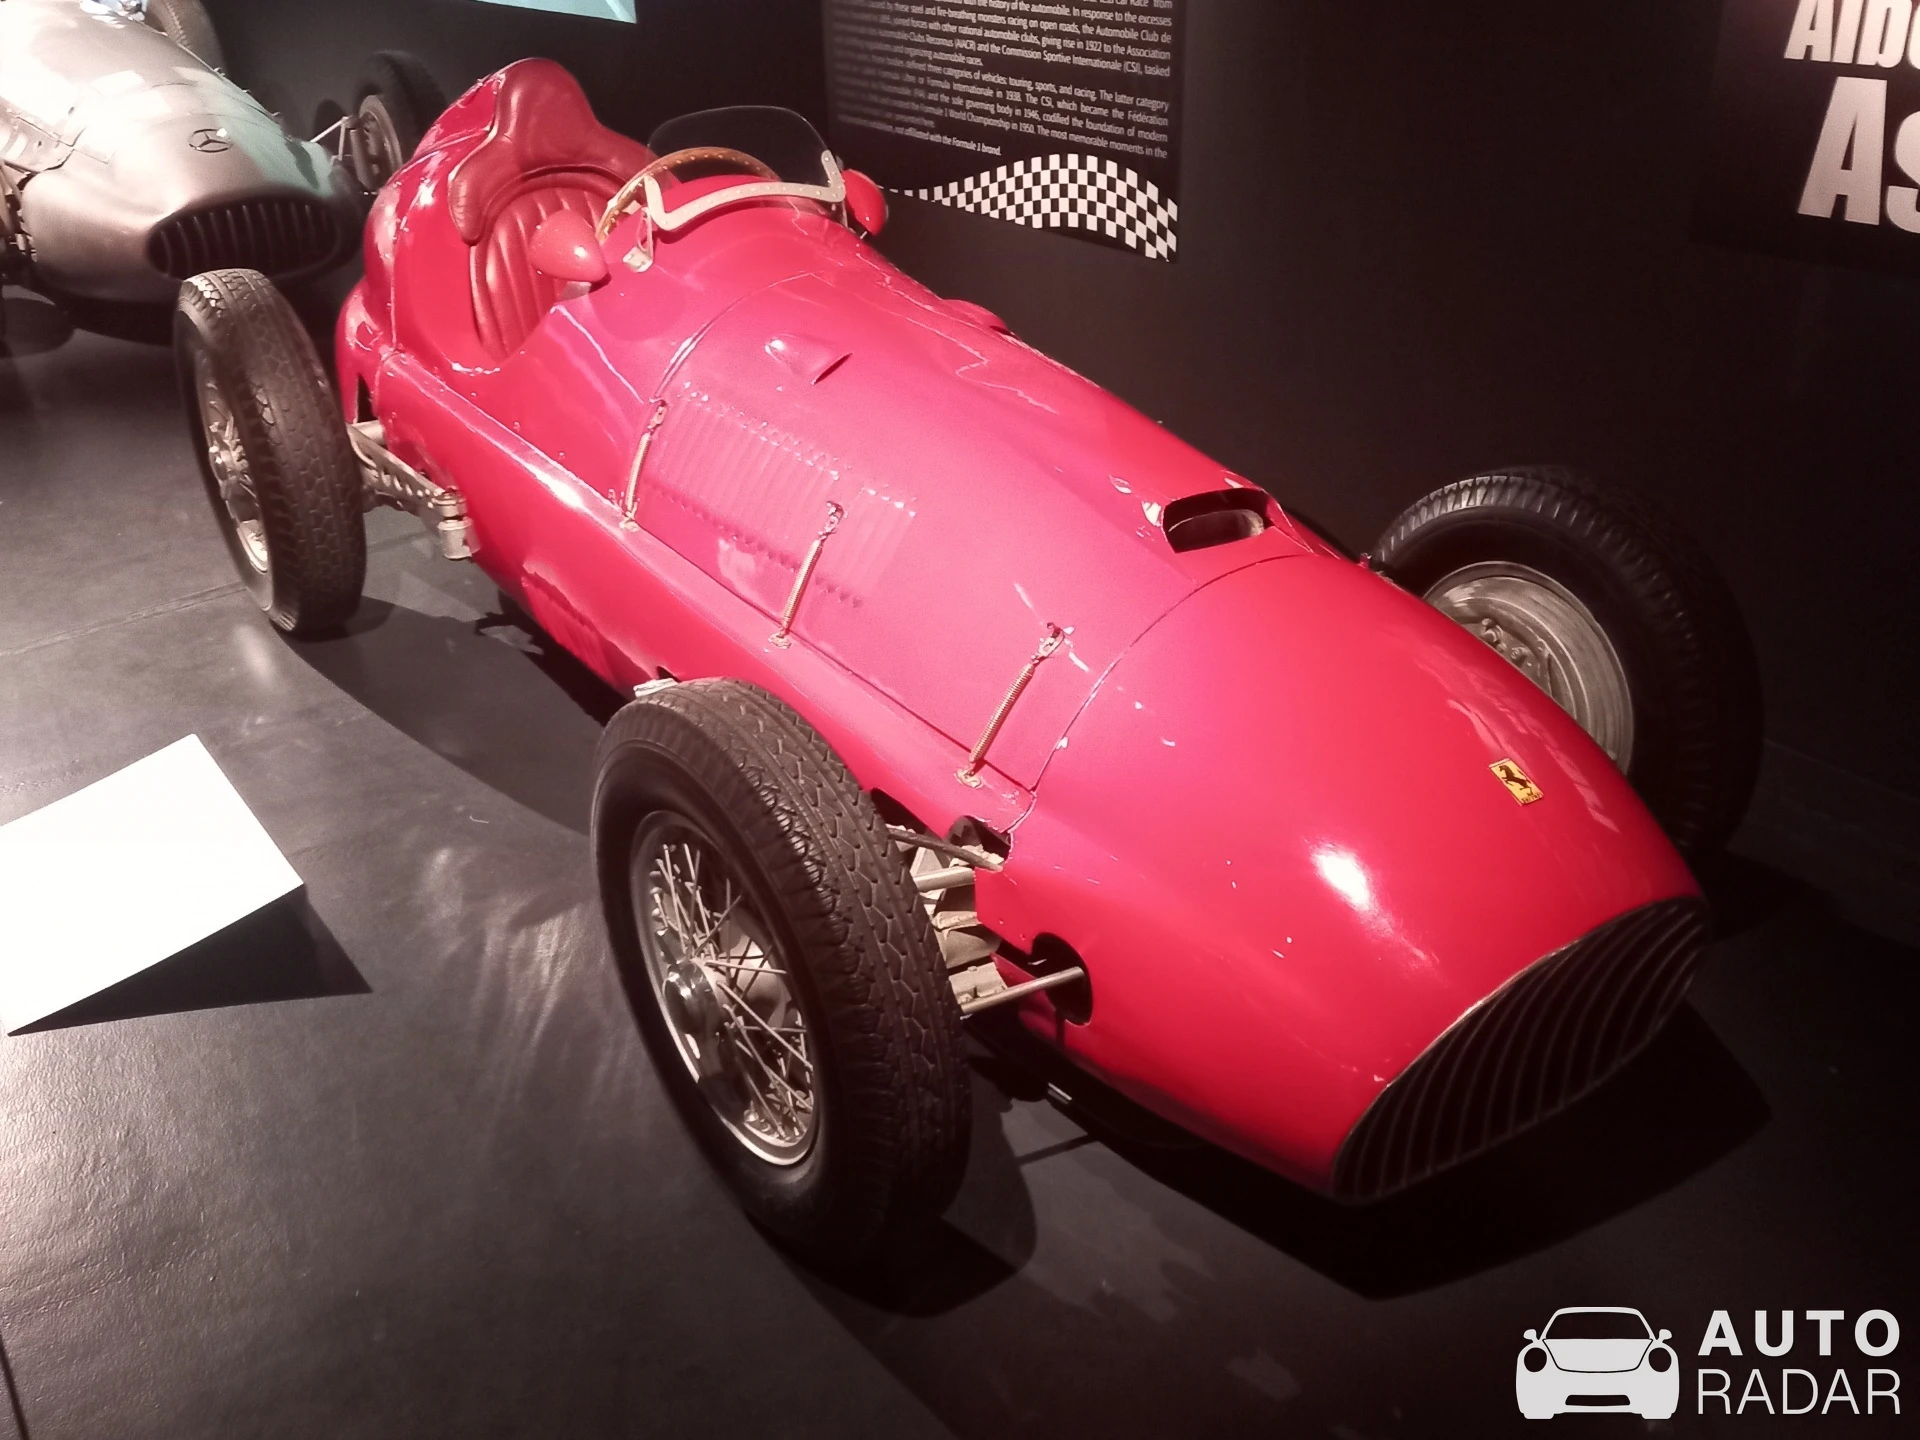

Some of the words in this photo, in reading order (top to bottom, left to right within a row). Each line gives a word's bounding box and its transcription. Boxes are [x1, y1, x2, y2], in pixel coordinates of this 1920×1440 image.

[925, 7, 936, 15] and
[978, 13, 1006, 24] monsters
[1008, 16, 1028, 29] racing
[1040, 21, 1058, 31] open
[1059, 22, 1080, 34] roads,
[1082, 23, 1094, 34] the
[1096, 25, 1139, 39] Automobile
[1141, 30, 1159, 42] Club
[1161, 32, 1172, 43] de
[988, 0, 1010, 12] history
[1011, 1, 1018, 10] of
[1019, 1, 1030, 11] the
[1031, 3, 1071, 15] automobile.
[1072, 6, 1080, 16] In
[1081, 10, 1114, 21] response
[1115, 11, 1123, 21] to
[1124, 11, 1137, 22] the
[1138, 16, 1172, 26] excesses
[928, 21, 940, 31] with
[942, 23, 957, 33] other
[958, 25, 982, 36] national
[984, 29, 1020, 41] automobile
[1021, 33, 1041, 45] clubs,
[1042, 35, 1062, 49] giving
[1063, 38, 1075, 48] rise
[1077, 39, 1084, 49] in
[1086, 40, 1102, 51] 1922
[1104, 42, 1112, 53] to
[1113, 43, 1126, 54] the
[1126, 45, 1170, 60] Association
[977, 43, 989, 52] and
[990, 43, 1001, 53] the
[1002, 45, 1042, 59] Commission
[1043, 50, 1072, 63] Sportive
[1073, 54, 1122, 70] Internationale
[1124, 61, 1142, 75] (CSI),
[1144, 63, 1170, 77] tasked
[943, 66, 972, 79] categories
[974, 71, 980, 80] of
[1009, 76, 1034, 91] touring,
[1035, 82, 1058, 94] sports,
[1059, 85, 1072, 95] and
[1074, 87, 1097, 101] racing.
[1100, 90, 1113, 101] The
[1115, 92, 1134, 104] latter
[1136, 96, 1169, 113] category
[952, 81, 994, 97] Internationale
[996, 89, 1003, 98] in
[1025, 94, 1038, 104] The
[1057, 99, 1077, 111] which
[1081, 103, 1108, 116] became
[1112, 108, 1124, 119] the
[1128, 110, 1168, 126] Fédération
[965, 100, 994, 114] governing
[996, 103, 1012, 117] body
[1014, 106, 1021, 116] in
[1042, 112, 1070, 125] codified
[1072, 116, 1084, 127] the
[1086, 119, 1124, 135] foundation
[1127, 126, 1135, 137] of
[1138, 129, 1168, 142] modern
[966, 112, 1010, 131] Championship
[1011, 120, 1018, 130] in
[1037, 125, 1050, 137] The
[1050, 130, 1068, 140] most
[1068, 134, 1108, 148] memorable
[1109, 141, 1144, 154] moments
[1146, 145, 1153, 156] in
[1154, 147, 1168, 159] the
[930, 133, 941, 143] with
[942, 135, 952, 145] the
[982, 143, 1001, 155] brand.
